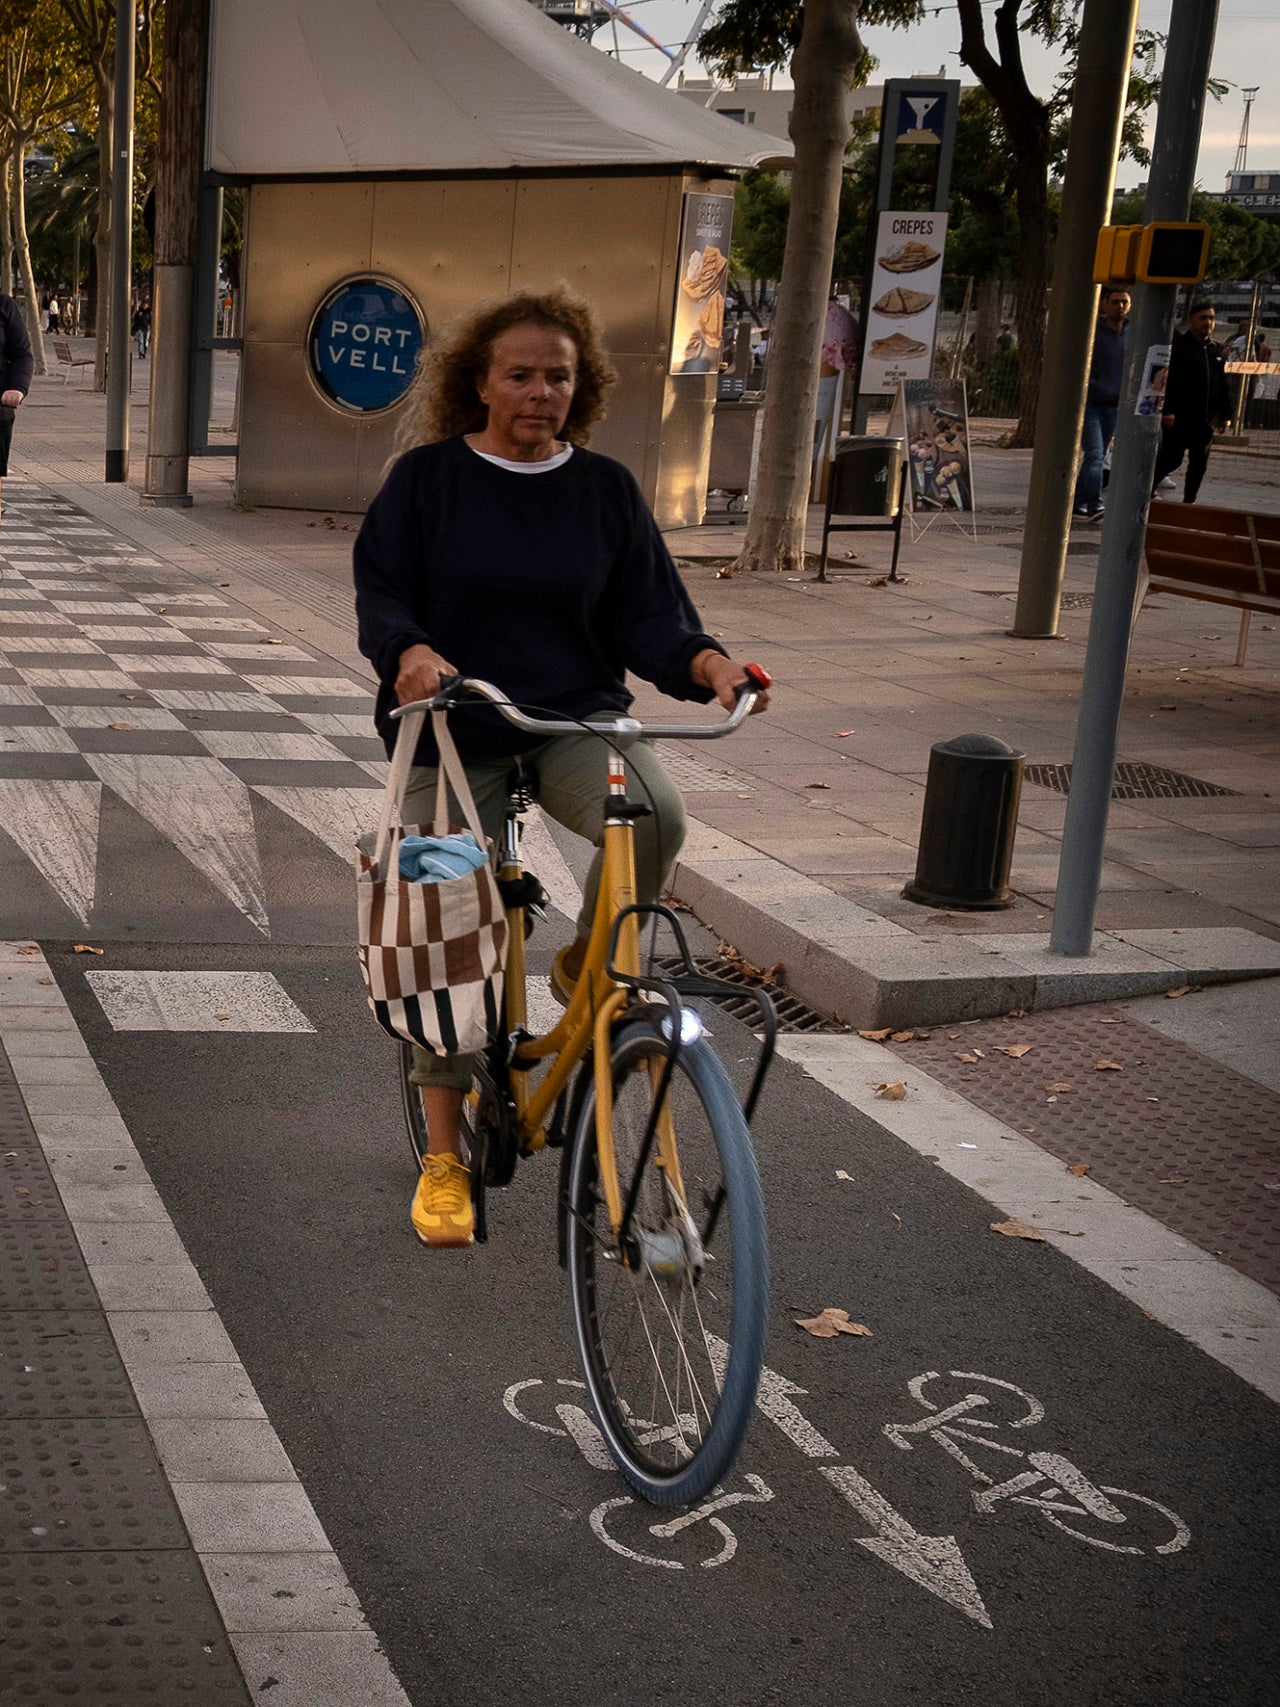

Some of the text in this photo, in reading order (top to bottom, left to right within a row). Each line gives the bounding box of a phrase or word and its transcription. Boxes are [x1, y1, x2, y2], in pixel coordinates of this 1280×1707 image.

[697, 202, 725, 227] CREPES
[892, 219, 934, 236] CREPES
[331, 320, 412, 348] PORT
[328, 345, 406, 375] VELL
